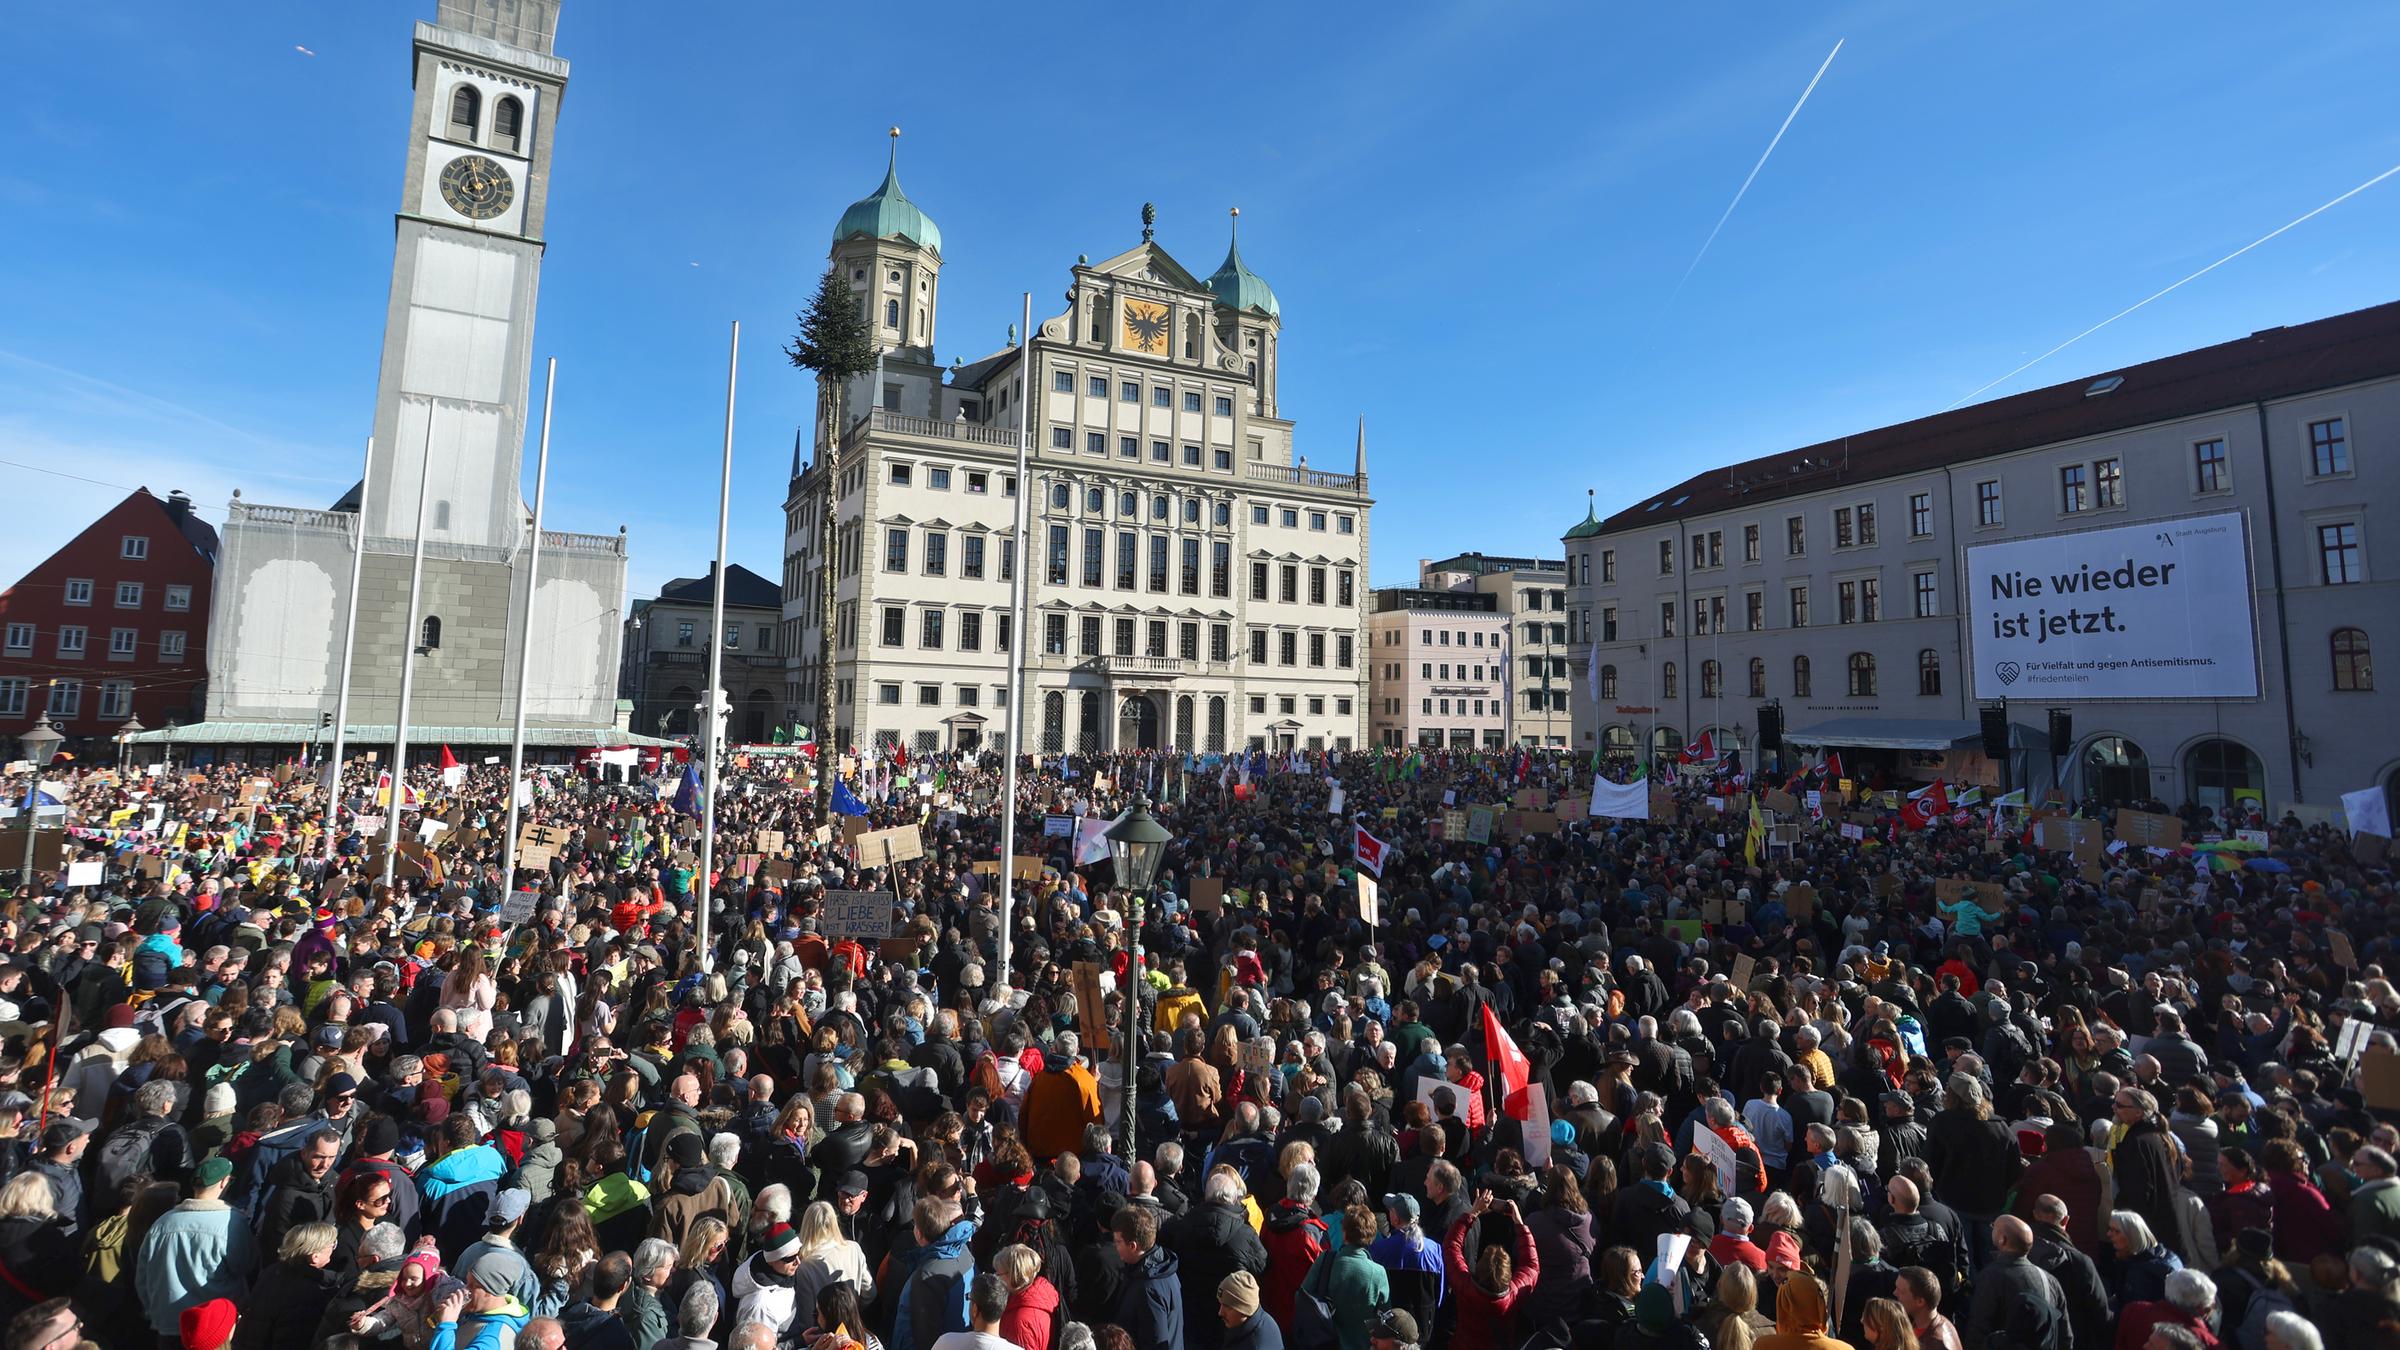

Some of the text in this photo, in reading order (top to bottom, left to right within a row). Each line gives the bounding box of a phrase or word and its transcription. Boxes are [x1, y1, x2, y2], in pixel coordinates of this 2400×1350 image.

[2175, 525, 2227, 538] Stadt Augsburg
[1991, 558, 2175, 600] Nie wieder
[1993, 606, 2126, 644] ist jetzt.
[2026, 656, 2216, 672] Für Vielfalt und gegen Antisemitismus.
[2027, 673, 2089, 684] #friedenteilen
[830, 895, 849, 906] HASS
[851, 896, 864, 905] IST
[837, 905, 875, 920] LIEBE
[826, 923, 840, 931] IST
